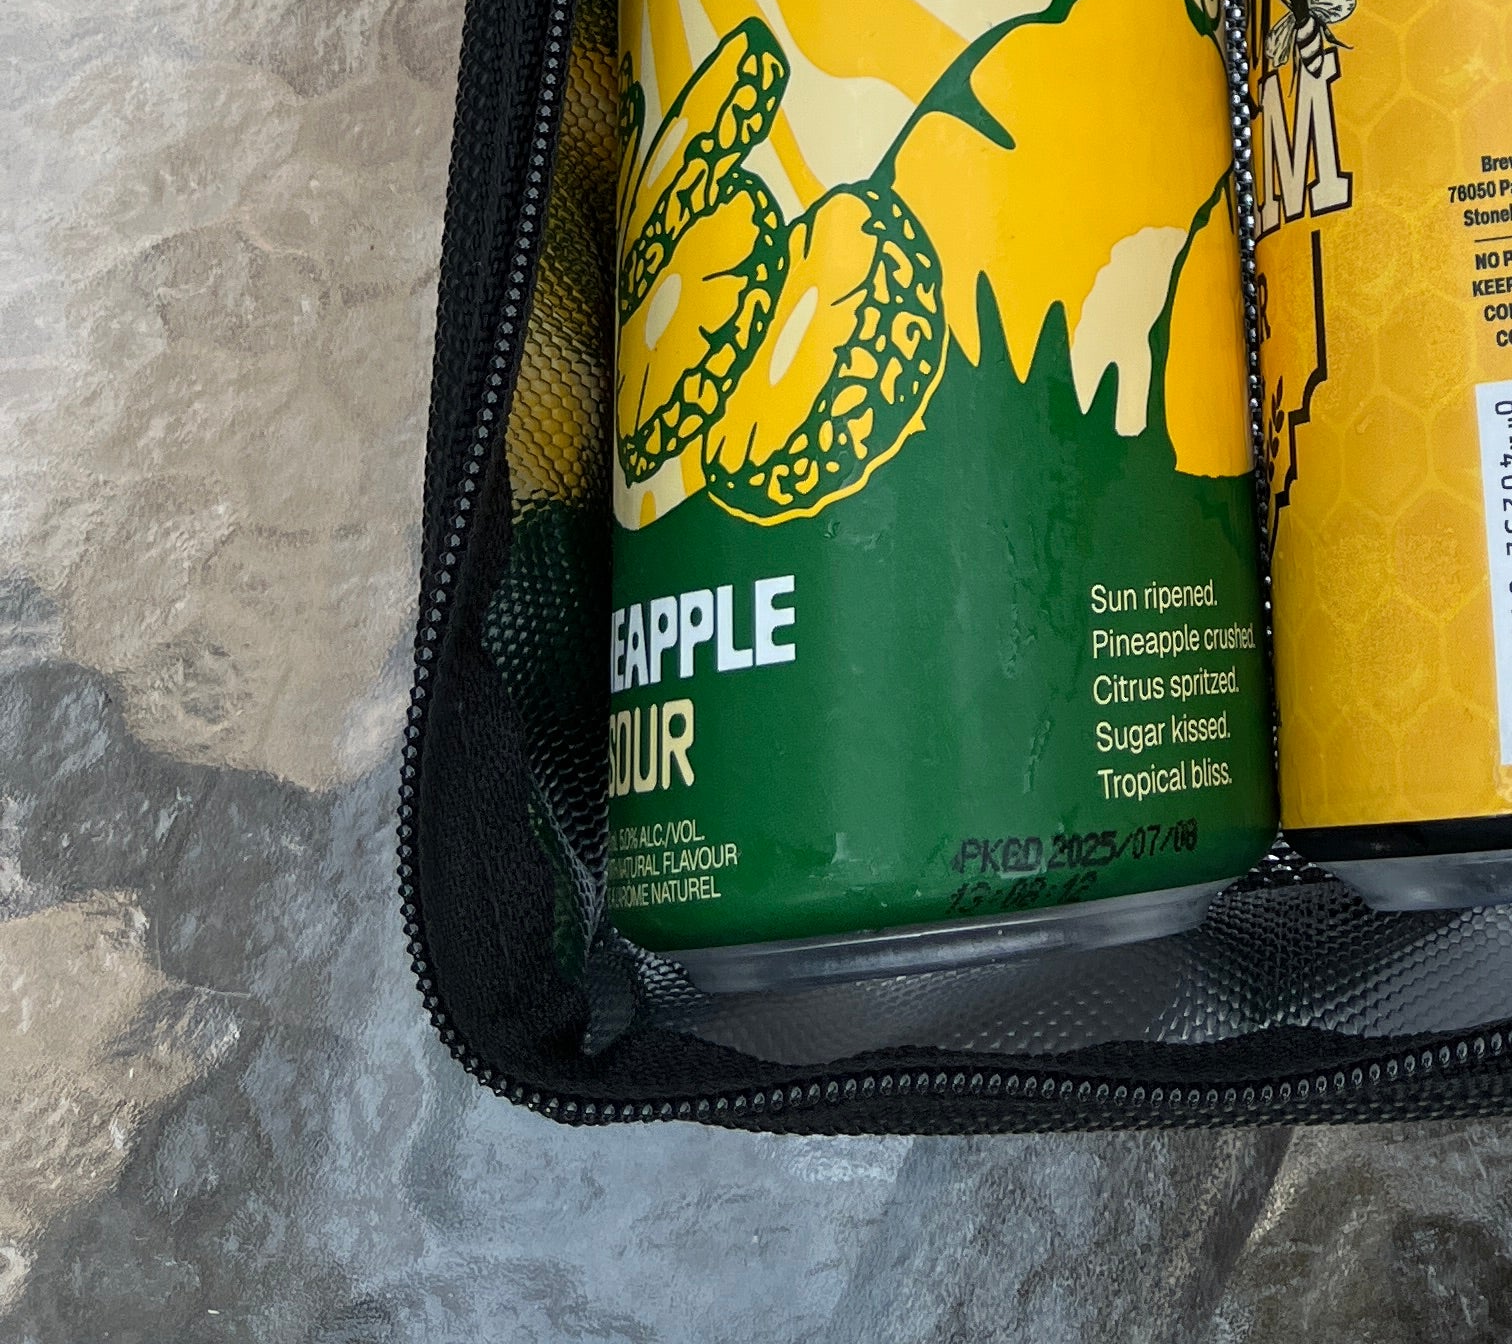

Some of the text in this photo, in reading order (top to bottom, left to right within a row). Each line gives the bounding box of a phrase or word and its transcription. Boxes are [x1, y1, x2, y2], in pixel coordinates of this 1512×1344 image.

[1474, 251, 1500, 271] NO
[1091, 578, 1219, 615] Sun ripened.
[610, 574, 796, 694] EAPPLE
[1092, 621, 1257, 660] Pineapple crushed.
[1092, 665, 1241, 706] Citrus spritzed.
[1095, 710, 1232, 755] Sugar kissed.
[1097, 757, 1233, 803] Tropical bliss.
[639, 818, 706, 849] ALC./VOL.
[662, 842, 739, 875] FLAVOUR
[651, 875, 722, 906] NATUREL
